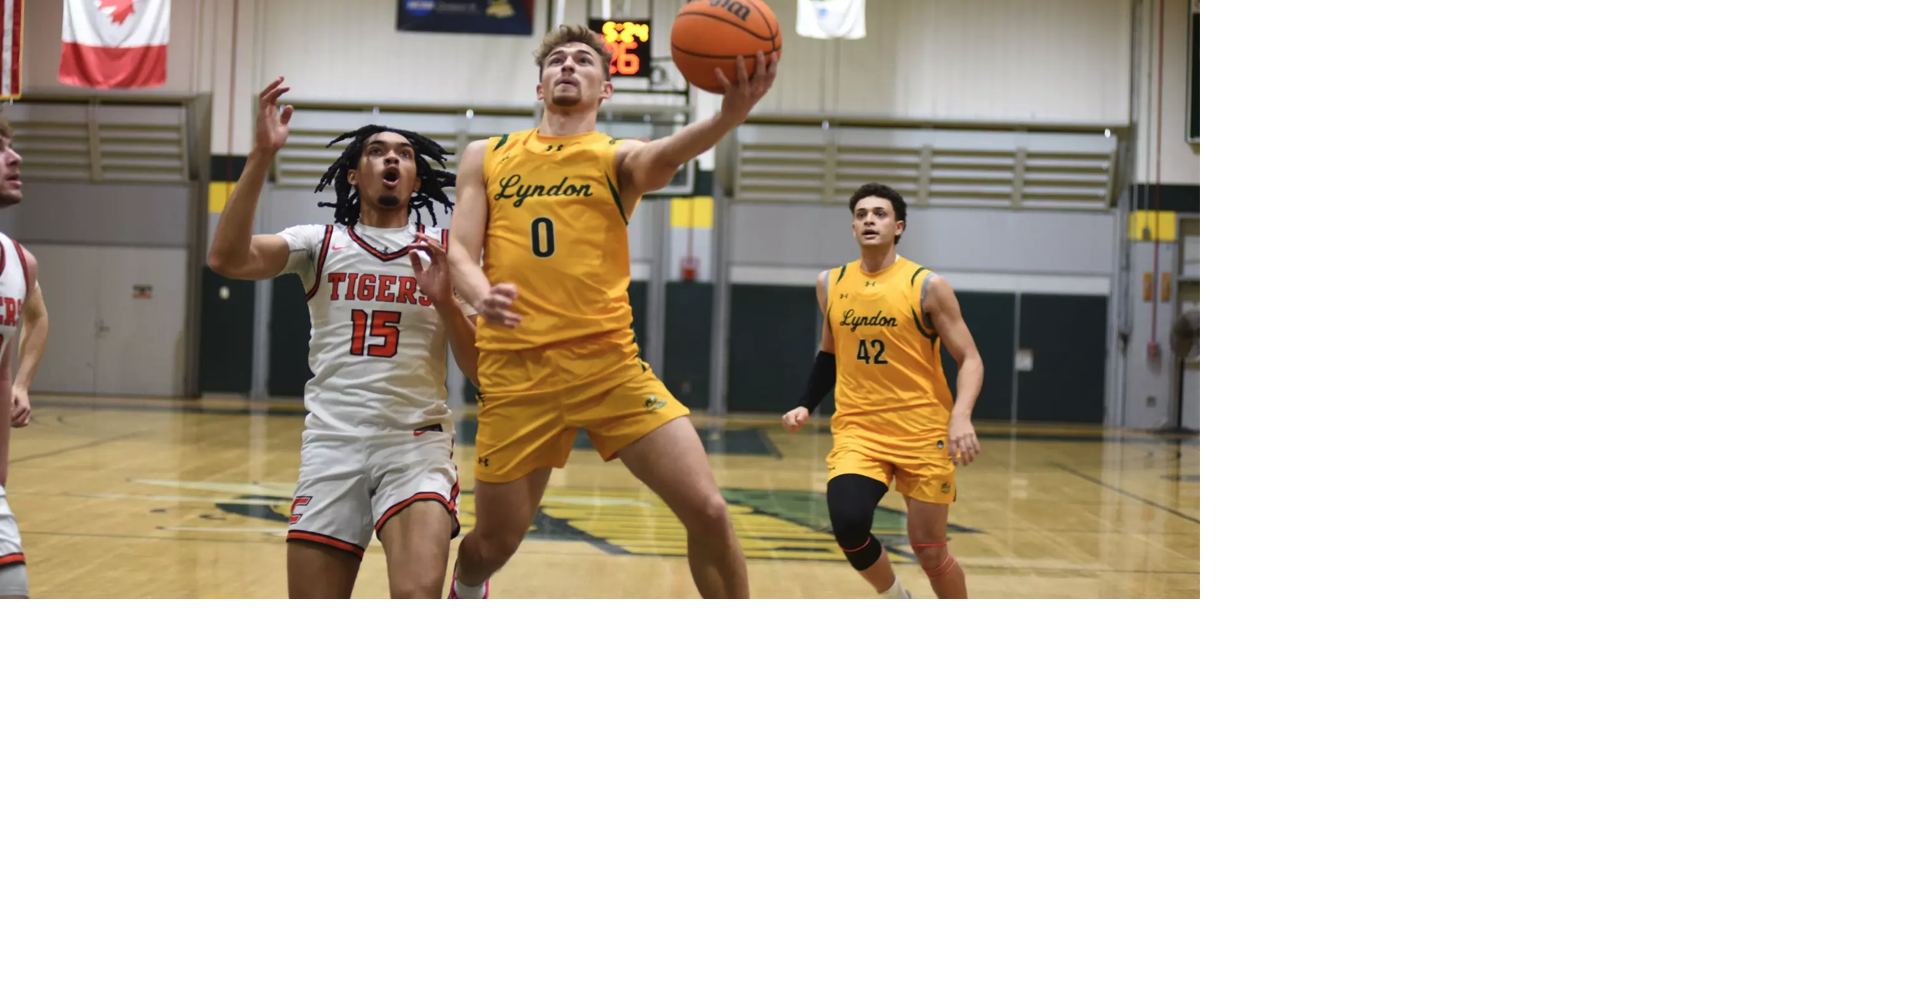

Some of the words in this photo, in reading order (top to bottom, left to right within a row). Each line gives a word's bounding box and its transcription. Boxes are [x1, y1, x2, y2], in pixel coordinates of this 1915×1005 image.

[602, 21, 649, 42] 5:24
[494, 174, 593, 208] Lyndon
[531, 217, 555, 258] 0
[350, 309, 402, 358] 15
[839, 309, 898, 332] Lyndon
[857, 338, 889, 365] 42
